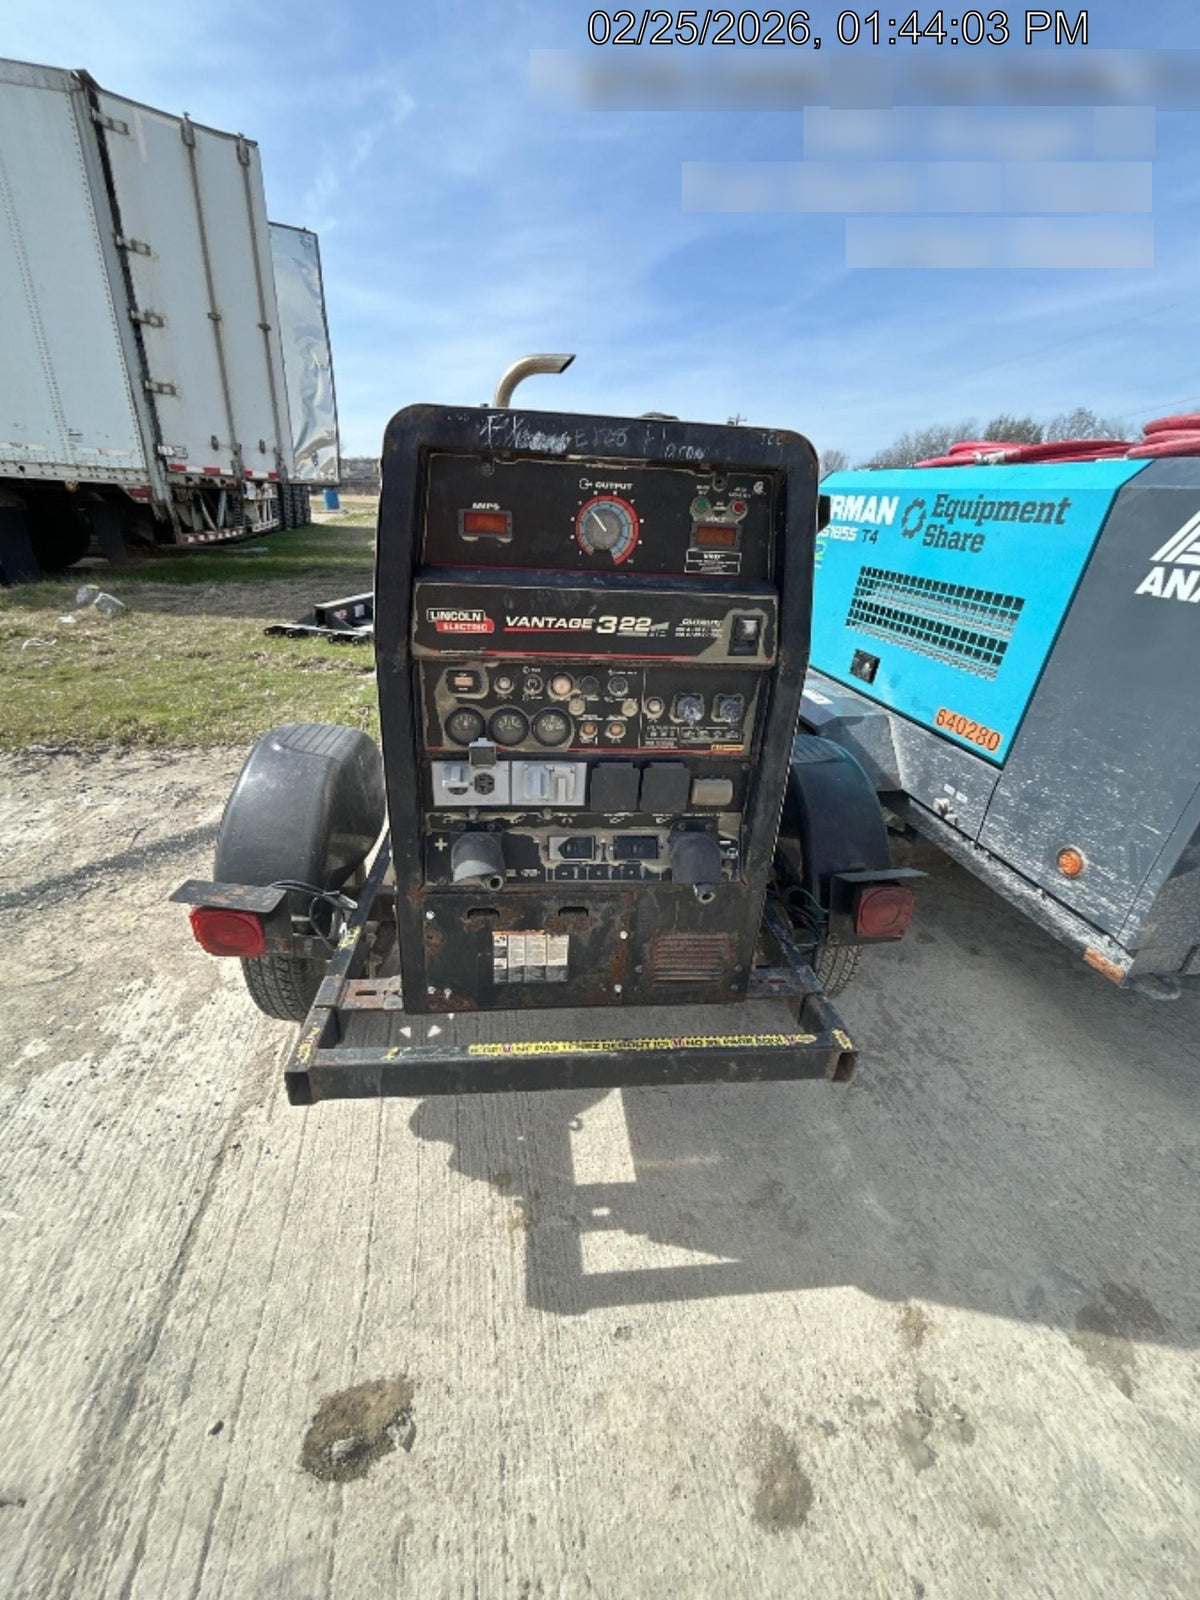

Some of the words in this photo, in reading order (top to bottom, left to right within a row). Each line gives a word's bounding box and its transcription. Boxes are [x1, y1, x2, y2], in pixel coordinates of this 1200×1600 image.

[595, 481, 635, 491] OUTPUT
[472, 502, 500, 511] AMPS
[932, 494, 1072, 527] Equipment
[862, 529, 879, 545] T4
[922, 524, 986, 553] Share
[429, 610, 482, 622] LINCOLN
[443, 622, 488, 632] ELECTRIC
[505, 615, 594, 629] VANTAGE
[596, 615, 652, 634] 322
[936, 708, 1001, 751] 640280
